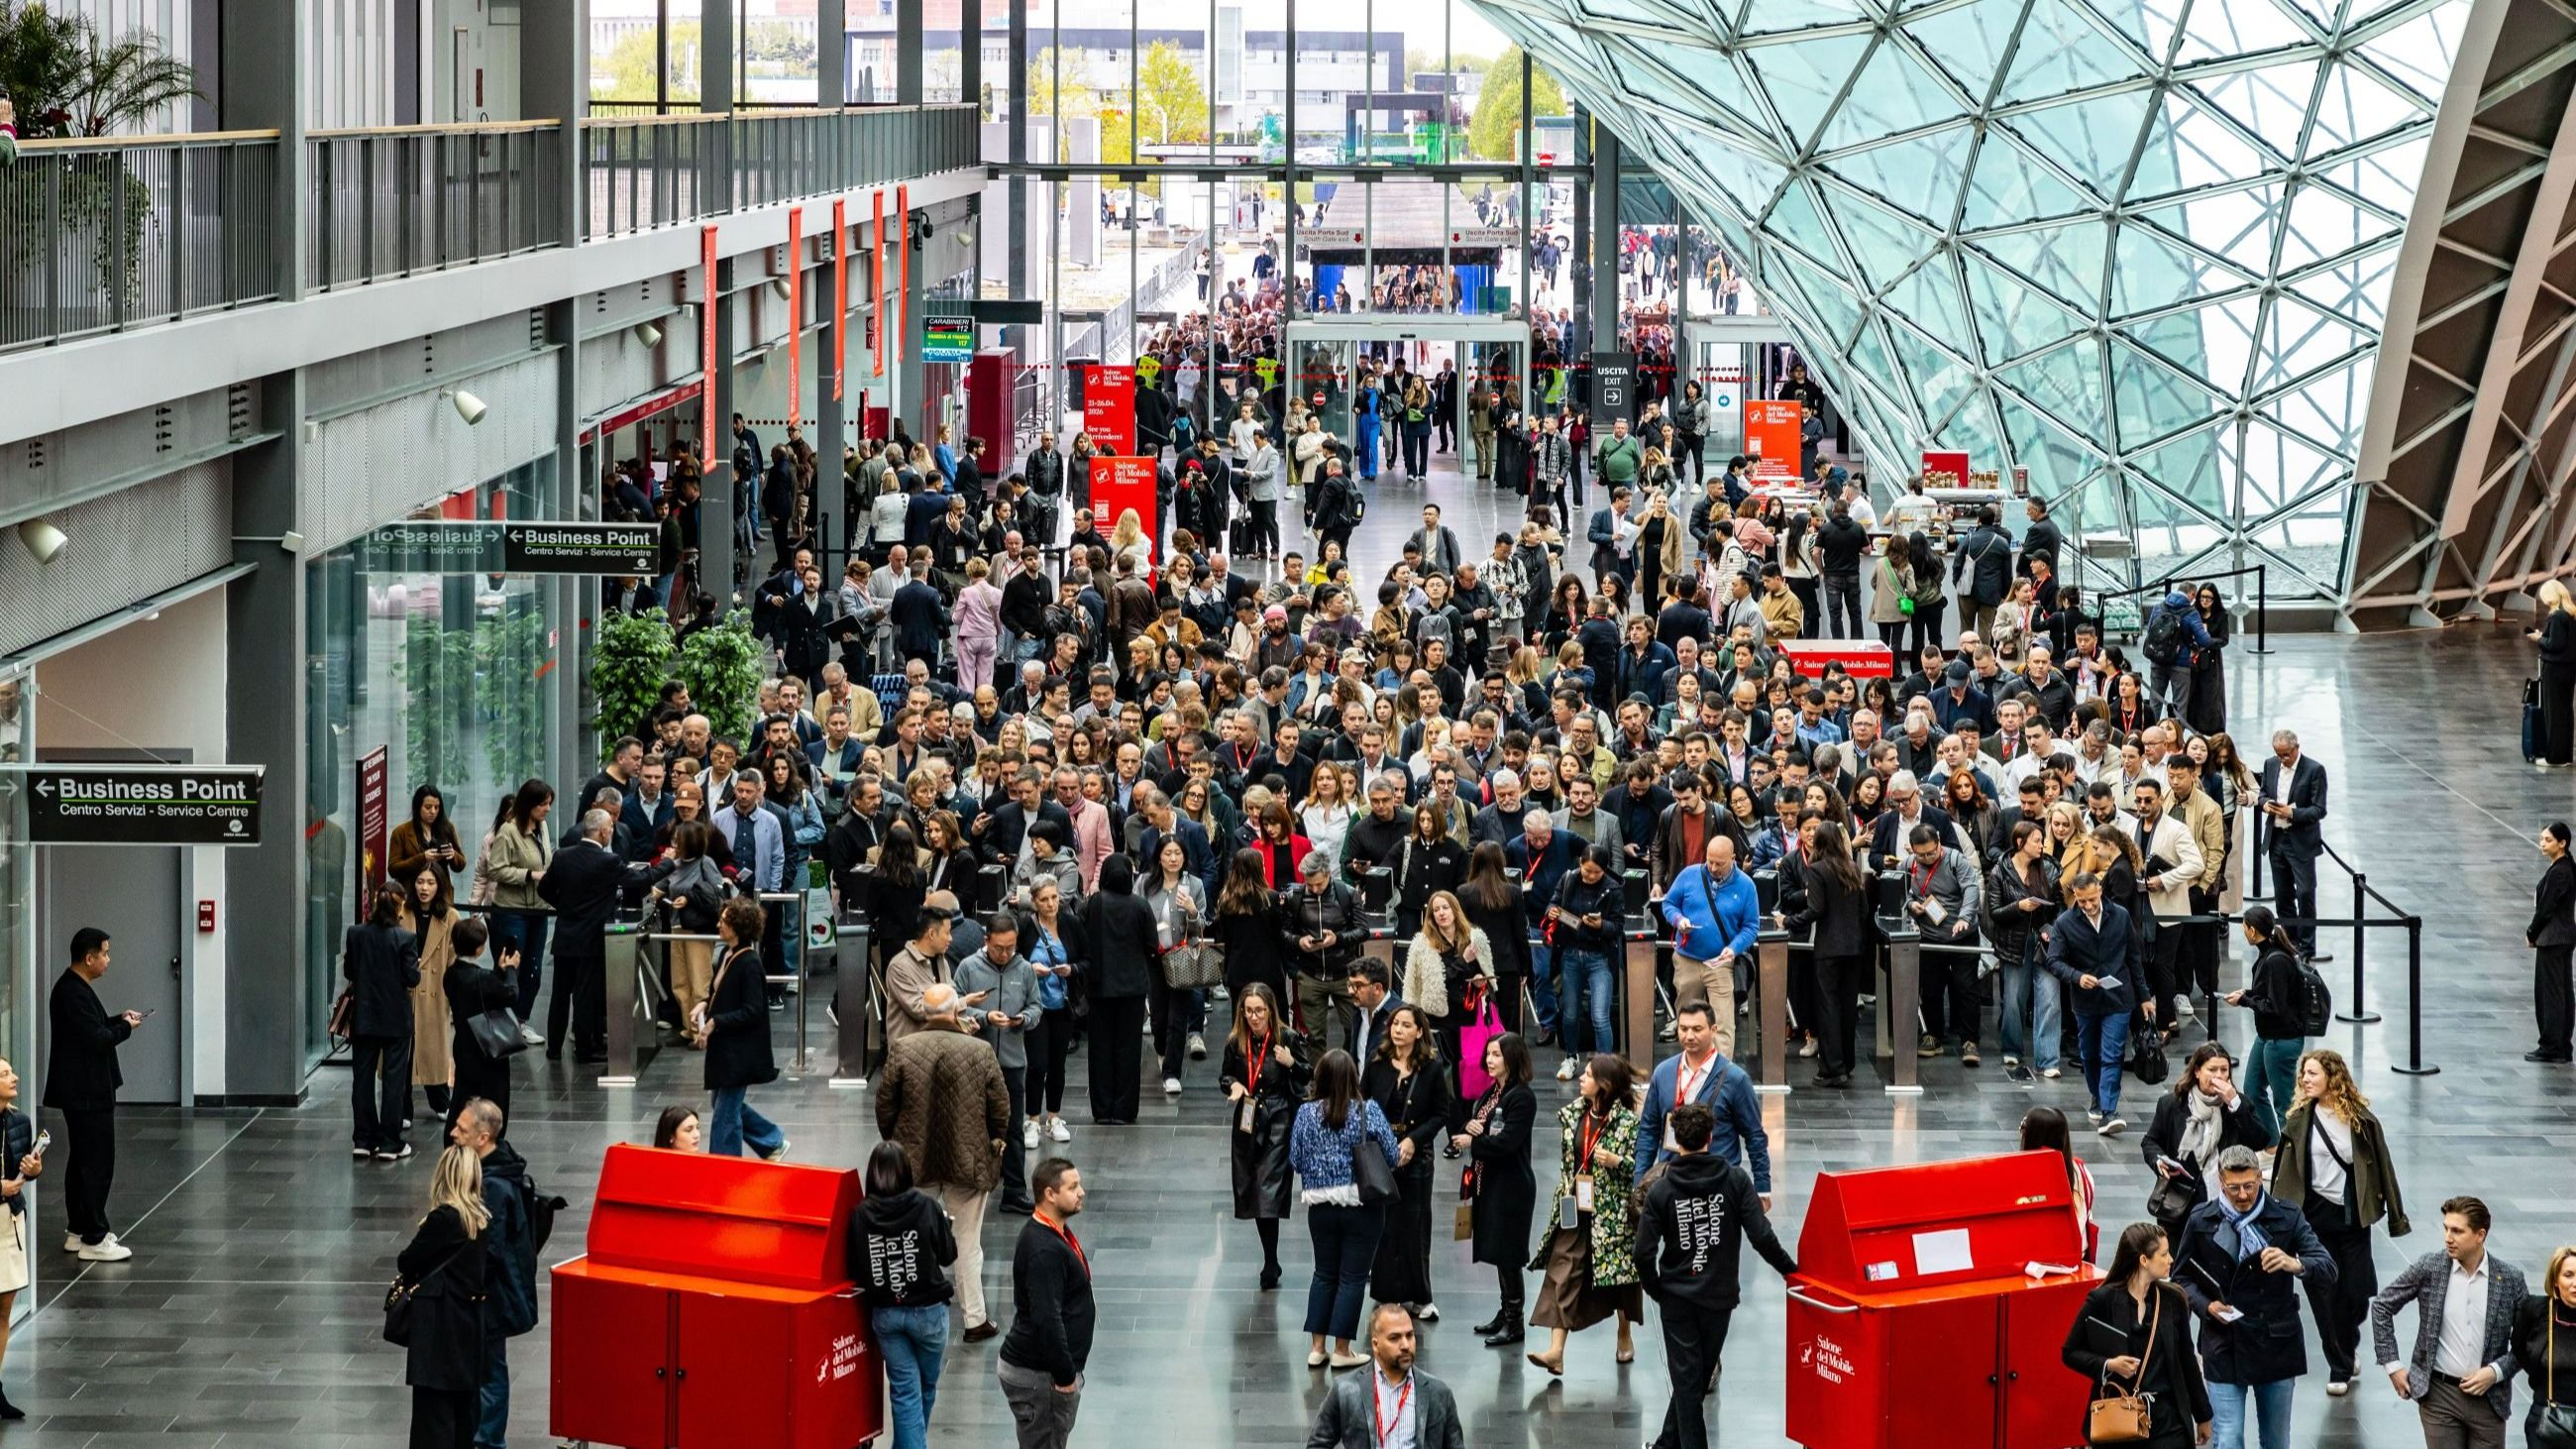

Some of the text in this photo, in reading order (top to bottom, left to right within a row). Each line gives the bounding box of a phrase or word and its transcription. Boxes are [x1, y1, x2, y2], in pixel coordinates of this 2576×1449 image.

[525, 530, 651, 545] Business Point
[525, 547, 554, 556] Centro
[555, 547, 583, 556] Servizi
[590, 548, 621, 557] Service
[59, 778, 247, 800] Business Point
[59, 804, 102, 816] Centro
[105, 804, 146, 816] Servizi
[158, 805, 203, 817] Service
[207, 805, 248, 817] Centre
[1675, 1198, 1692, 1250] Milano
[1709, 1193, 1724, 1245] Salone
[1692, 1198, 1710, 1277] del Mobile.
[868, 1234, 886, 1286] Milano
[902, 1230, 919, 1282] Salone
[833, 1334, 855, 1352] Salone
[1817, 1334, 1842, 1356] Salone
[833, 1350, 843, 1366] del
[1817, 1349, 1855, 1376] del Mobile.
[833, 1362, 856, 1381] Milano
[1817, 1362, 1842, 1384] Milano
